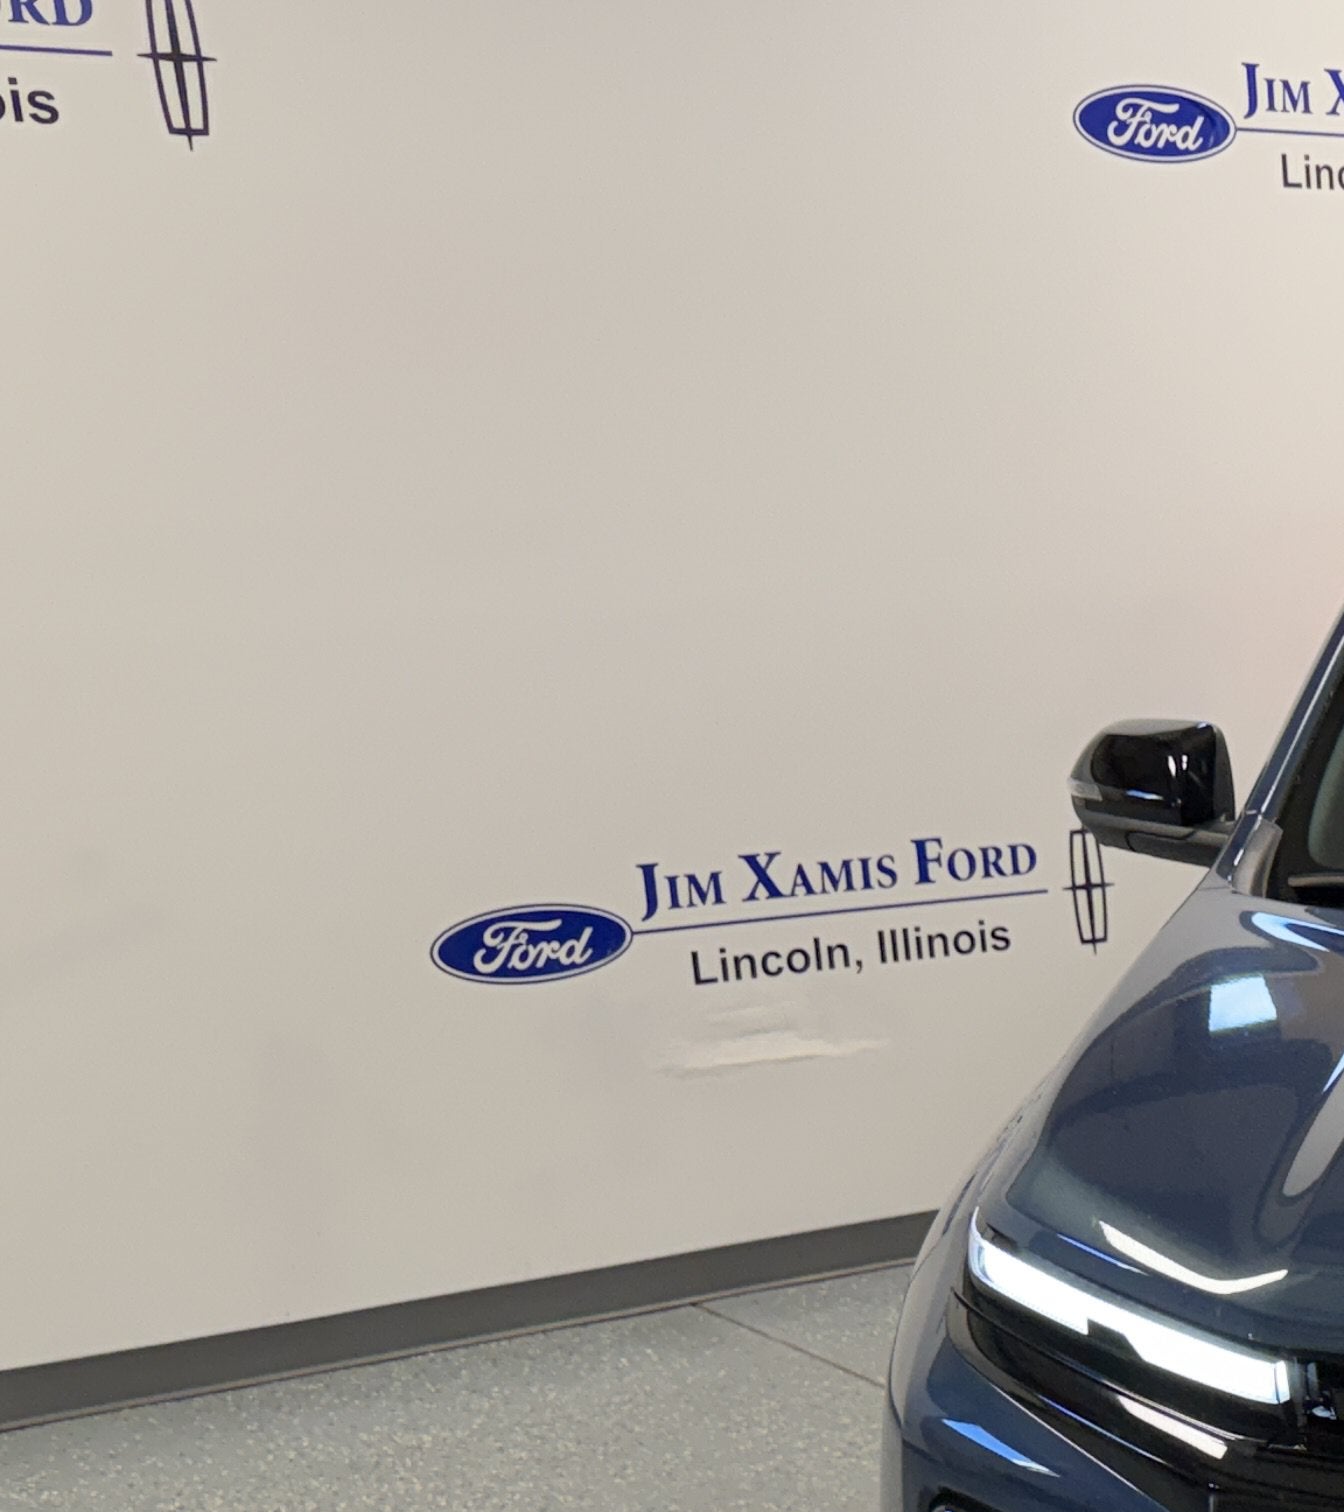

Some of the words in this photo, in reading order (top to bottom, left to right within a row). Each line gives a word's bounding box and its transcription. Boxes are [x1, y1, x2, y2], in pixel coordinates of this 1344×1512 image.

[1241, 62, 1312, 119] JIM
[1107, 97, 1205, 152] Ford
[636, 862, 723, 922] JIM
[737, 850, 898, 902] XAMIS
[911, 837, 1038, 886] FORD
[473, 918, 594, 974] Ford
[690, 936, 865, 986] Lincoln,
[877, 919, 1012, 965] Illinois
